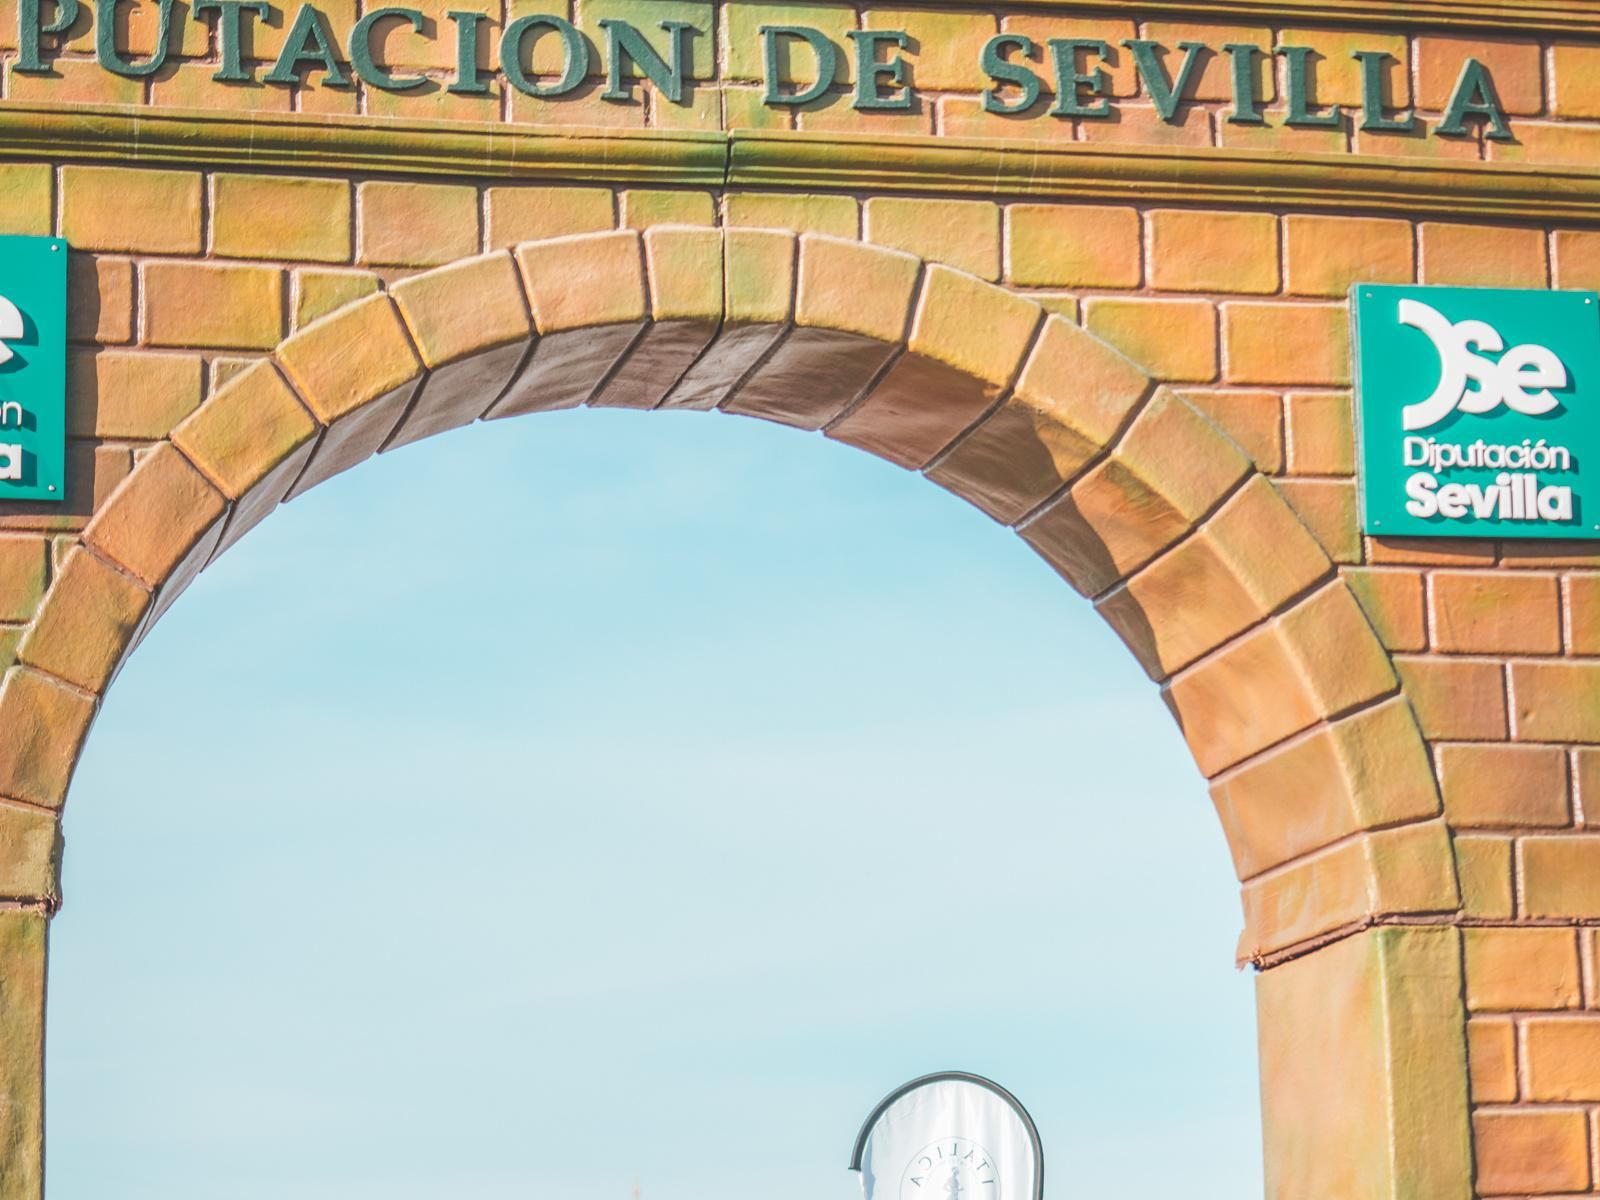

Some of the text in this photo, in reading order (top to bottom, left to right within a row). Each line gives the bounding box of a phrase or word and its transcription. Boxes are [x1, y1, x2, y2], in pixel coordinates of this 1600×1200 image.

[12, 0, 1513, 140] PUTACION DE SEVILLA
[1403, 436, 1571, 474] Diputación
[1405, 472, 1573, 520] Sevilla
